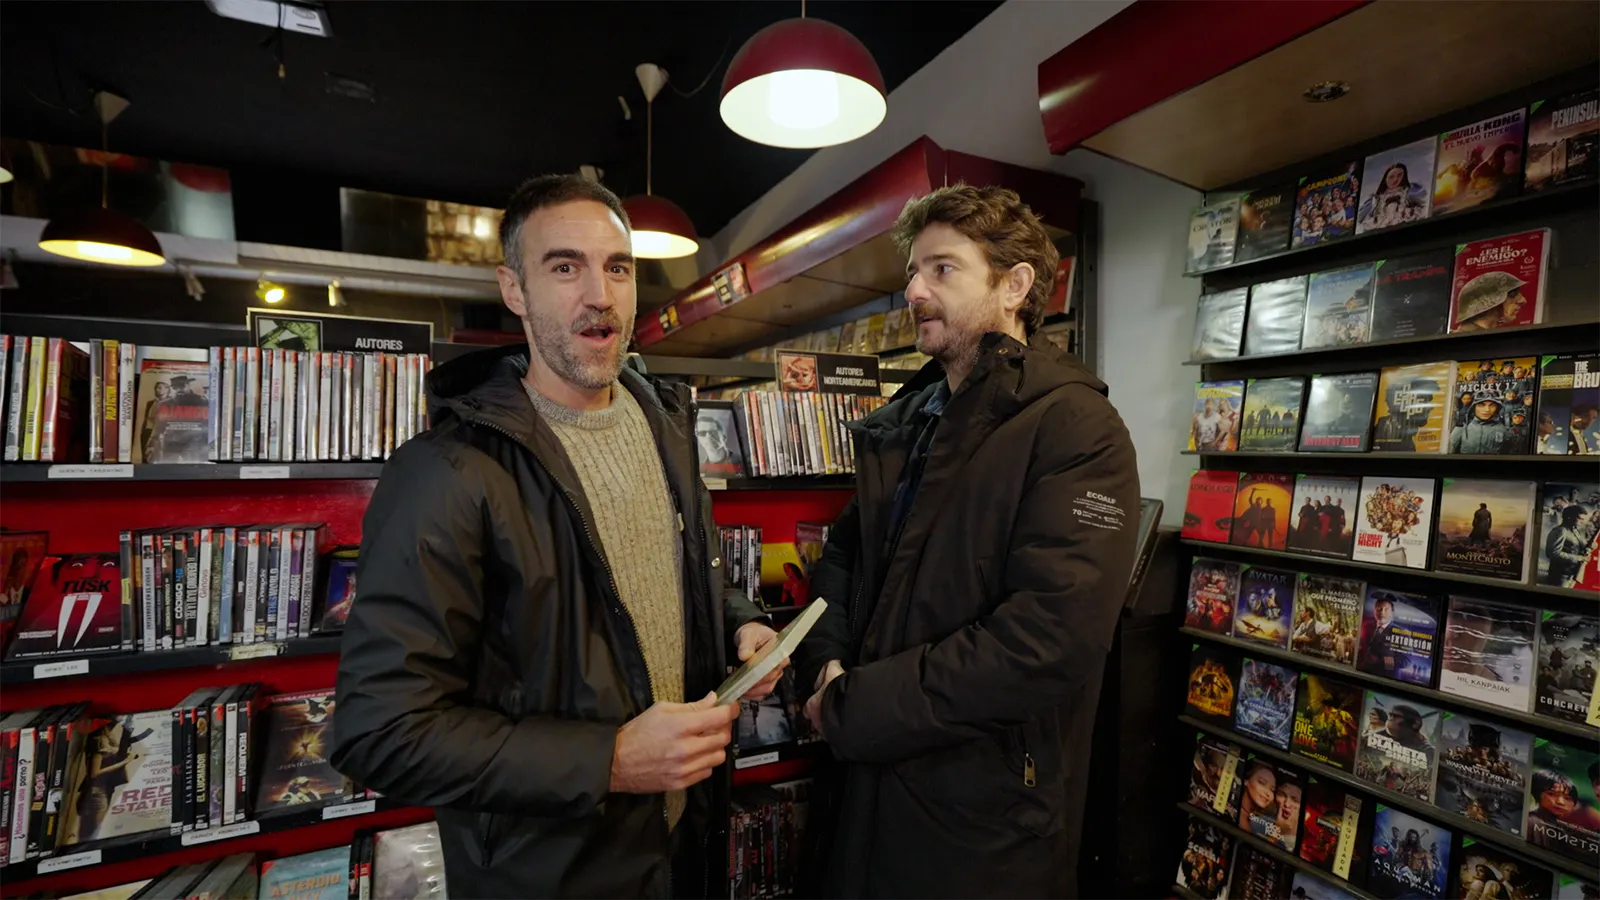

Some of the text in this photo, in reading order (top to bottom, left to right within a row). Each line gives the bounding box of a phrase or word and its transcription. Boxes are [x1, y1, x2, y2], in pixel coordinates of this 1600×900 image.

[1466, 248, 1528, 266] ENEMIGO?
[355, 337, 403, 351] AUTORES
[836, 367, 864, 377] AUTORES
[1574, 361, 1589, 373] THE
[823, 376, 877, 387] NORTEAMERICANOS
[1459, 381, 1517, 392] MICKEY 17
[1573, 372, 1600, 388] BRU
[1086, 491, 1117, 505] ECOALF
[1072, 508, 1082, 516] 70
[1357, 539, 1382, 549] NIGHT
[1446, 551, 1511, 565] MONTECRISTO
[199, 568, 208, 598] Génova
[269, 568, 278, 596] WORLD
[1250, 570, 1288, 584] AVATAR
[61, 580, 112, 594] TUSK
[1310, 592, 1324, 600] QUE
[1329, 589, 1358, 600] MAESTRO
[174, 583, 183, 619] CÓDIGO
[268, 596, 277, 615] THIS
[302, 582, 311, 617] DOCTRINA
[1391, 634, 1432, 651] EXTORSIÓN
[1457, 675, 1511, 693] HIL KANPAIAK
[1294, 721, 1314, 735] ONE
[1293, 733, 1319, 750] LOVE
[1367, 735, 1427, 762] PLANETA
[238, 732, 247, 776] REQUIEM
[1385, 750, 1428, 769] SIMIOS
[19, 766, 28, 787] porno
[197, 753, 206, 802] EL LUCHADOR
[1446, 760, 1518, 786] WAKANDA FOREVER
[122, 784, 172, 803] RED
[185, 793, 192, 803] LA
[111, 796, 172, 815] STATE
[1249, 812, 1282, 834] Sin malos
[1339, 815, 1354, 871] ALQUILADA
[1374, 858, 1441, 893] AQUAMAN
[272, 872, 341, 898] ASTEROID
